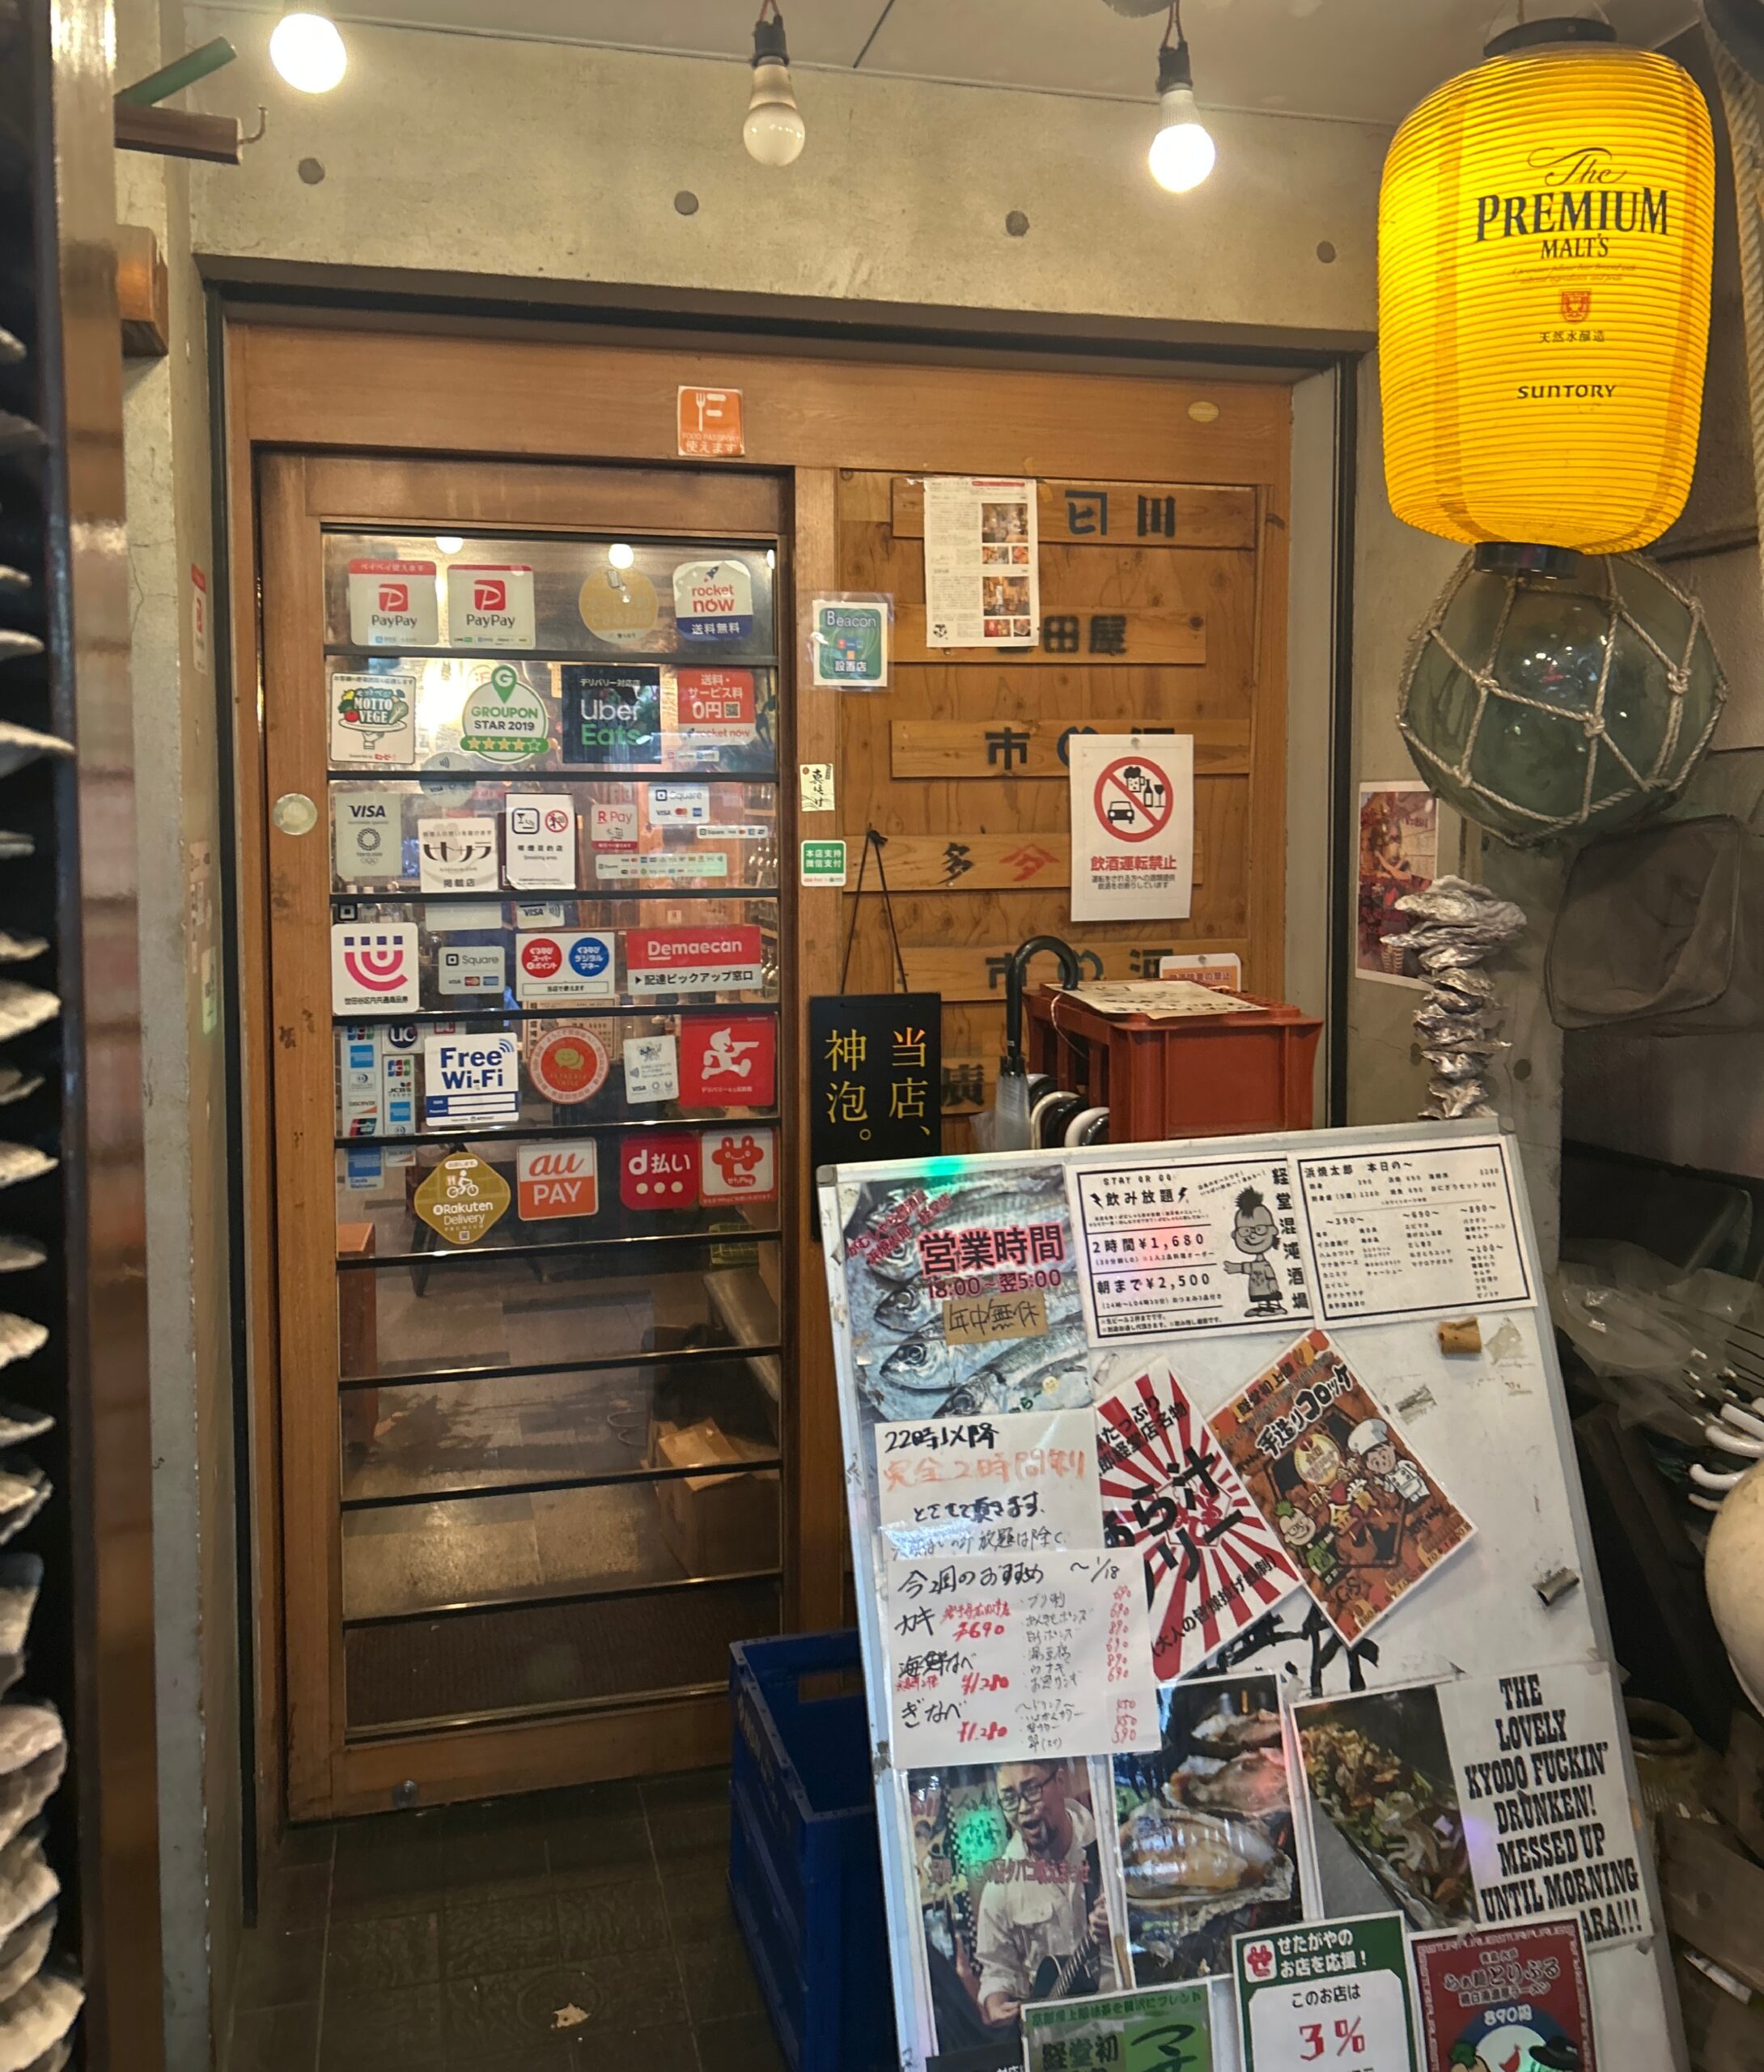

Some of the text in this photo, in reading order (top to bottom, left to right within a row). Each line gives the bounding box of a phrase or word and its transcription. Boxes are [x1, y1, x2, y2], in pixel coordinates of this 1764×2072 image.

[1528, 147, 1627, 186] The
[1475, 187, 1669, 242] PREMIUM
[1541, 233, 1609, 259] MALT'S
[1539, 330, 1605, 343] 天然水醸造
[1517, 384, 1617, 399] SUNTORY
[686, 440, 736, 454] 使えます
[692, 584, 734, 597] rocket
[693, 599, 735, 613] now
[371, 615, 418, 628] PayPay
[466, 614, 515, 628] PayPay
[826, 610, 876, 627] Beacon
[692, 622, 740, 635] 送料無料
[834, 660, 867, 672] 設置店
[688, 687, 743, 698] サービス料
[354, 698, 392, 710] MOTTO
[472, 706, 538, 719] GROUPON
[581, 699, 640, 720] Uber
[692, 701, 721, 719] 0円
[359, 711, 388, 724] VEGE
[474, 720, 535, 731] STAR 2019
[581, 724, 642, 745] Eats
[730, 729, 750, 737] now
[348, 805, 386, 817] VISA
[610, 811, 632, 824] Pay
[806, 849, 842, 858] 本店支持
[805, 860, 842, 868] 微信支付
[1090, 856, 1177, 872] 飲酒運転禁止
[524, 908, 546, 917] VISA
[647, 939, 743, 956] Demaecan
[461, 955, 499, 966] Square
[644, 970, 753, 986] 配達ピックアップ窓口
[440, 1047, 502, 1068] Free
[442, 1069, 503, 1089] Wi-Fi
[528, 1152, 585, 1177] au
[628, 1149, 690, 1175] d払い
[1304, 1164, 1353, 1178] 浜焼太郎
[1103, 1177, 1131, 1186] STAY
[533, 1182, 582, 1206] PAY
[1105, 1188, 1174, 1207] 飲み放題
[443, 1202, 494, 1214] Rakuten
[443, 1213, 486, 1225] Delivery
[918, 1223, 1066, 1279] 営業時間
[948, 1297, 1040, 1335] 年中無休
[1256, 1363, 1354, 1458] 手造りコロッケ
[1097, 1395, 1160, 1450] たっぷり
[884, 1422, 999, 1453] 22時以降
[883, 1449, 1086, 1492] 完全2時間制
[897, 1561, 1044, 1599] 今週のおすすめ
[894, 1606, 935, 1637] カキ
[1499, 1674, 1543, 1710] THE
[1495, 1709, 1567, 1751] LOVELY
[1464, 1741, 1609, 1800] KYODO FUCKIN'
[1494, 1784, 1598, 1835] DRUNKEN!
[1497, 1822, 1606, 1878] MESSED UP
[1480, 1858, 1641, 1924] UNTIL MORNING
[1277, 1929, 1354, 1954] せたがやの
[1291, 1985, 1362, 2009] このお店は
